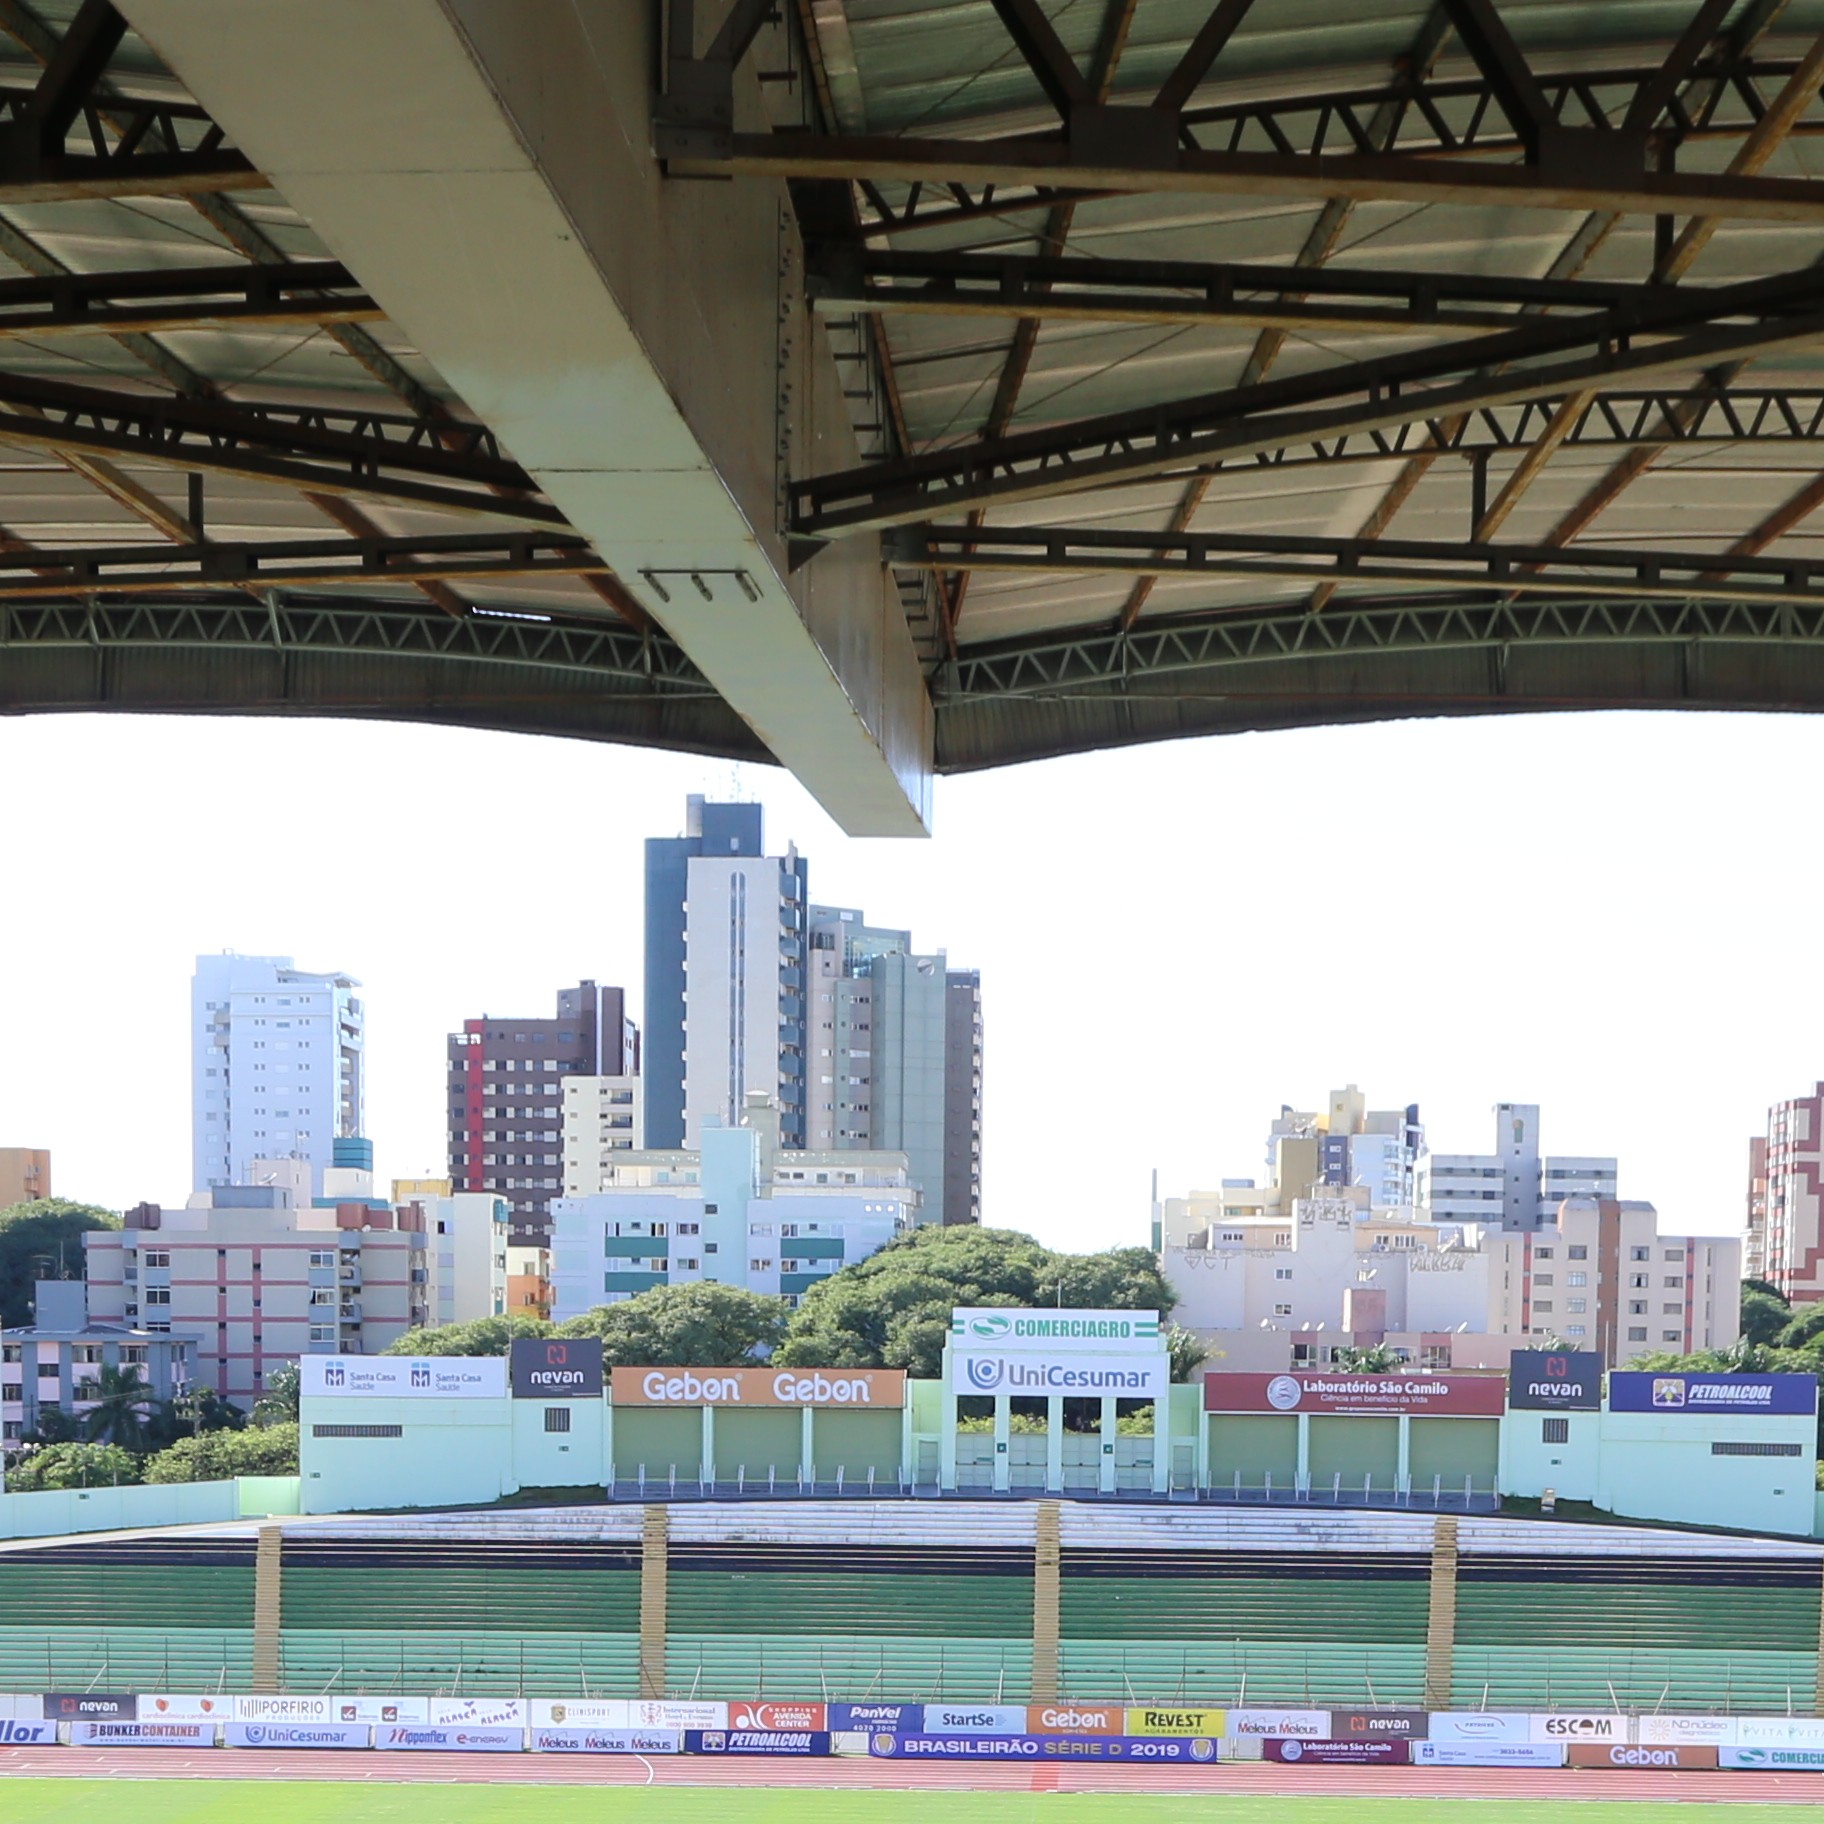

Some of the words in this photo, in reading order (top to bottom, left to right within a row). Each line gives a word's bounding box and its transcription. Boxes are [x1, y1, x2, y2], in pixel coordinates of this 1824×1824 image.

[1014, 1319, 1131, 1338] COMERCIAGRO
[350, 1371, 374, 1382] Santa
[376, 1373, 396, 1382] Casa
[436, 1373, 460, 1383] Santa
[461, 1374, 482, 1383] Casa
[531, 1370, 584, 1385] nevan
[1009, 1364, 1151, 1388] UniCesumar
[643, 1371, 740, 1401] Gebon
[773, 1373, 870, 1402] Gebon
[1303, 1380, 1377, 1394] Laboratório
[1379, 1381, 1403, 1394] São
[1405, 1382, 1449, 1395] Camilo
[1528, 1382, 1582, 1397] nevan
[1688, 1384, 1773, 1401] PETROALCOOL
[1399, 1395, 1410, 1403] da
[1411, 1396, 1428, 1404] Vida
[79, 1700, 118, 1712] nevan
[262, 1701, 324, 1714] PORFIRIO
[775, 1720, 810, 1728] CENTER
[942, 1713, 994, 1726] StartSe
[1041, 1709, 1108, 1729] Gebon
[1369, 1718, 1410, 1730] nevan
[268, 1729, 347, 1742] UniCesumar
[728, 1733, 812, 1747] PETROALCOOL
[904, 1738, 1038, 1754] BRASILEIRÃO
[1044, 1740, 1103, 1755] SÉRIE
[1109, 1743, 1123, 1755] D
[1130, 1744, 1180, 1757] 2019
[1303, 1742, 1349, 1751] Laboratório
[1349, 1743, 1364, 1751] São
[1365, 1743, 1392, 1752] Camilo
[1610, 1745, 1679, 1766] Gebon
